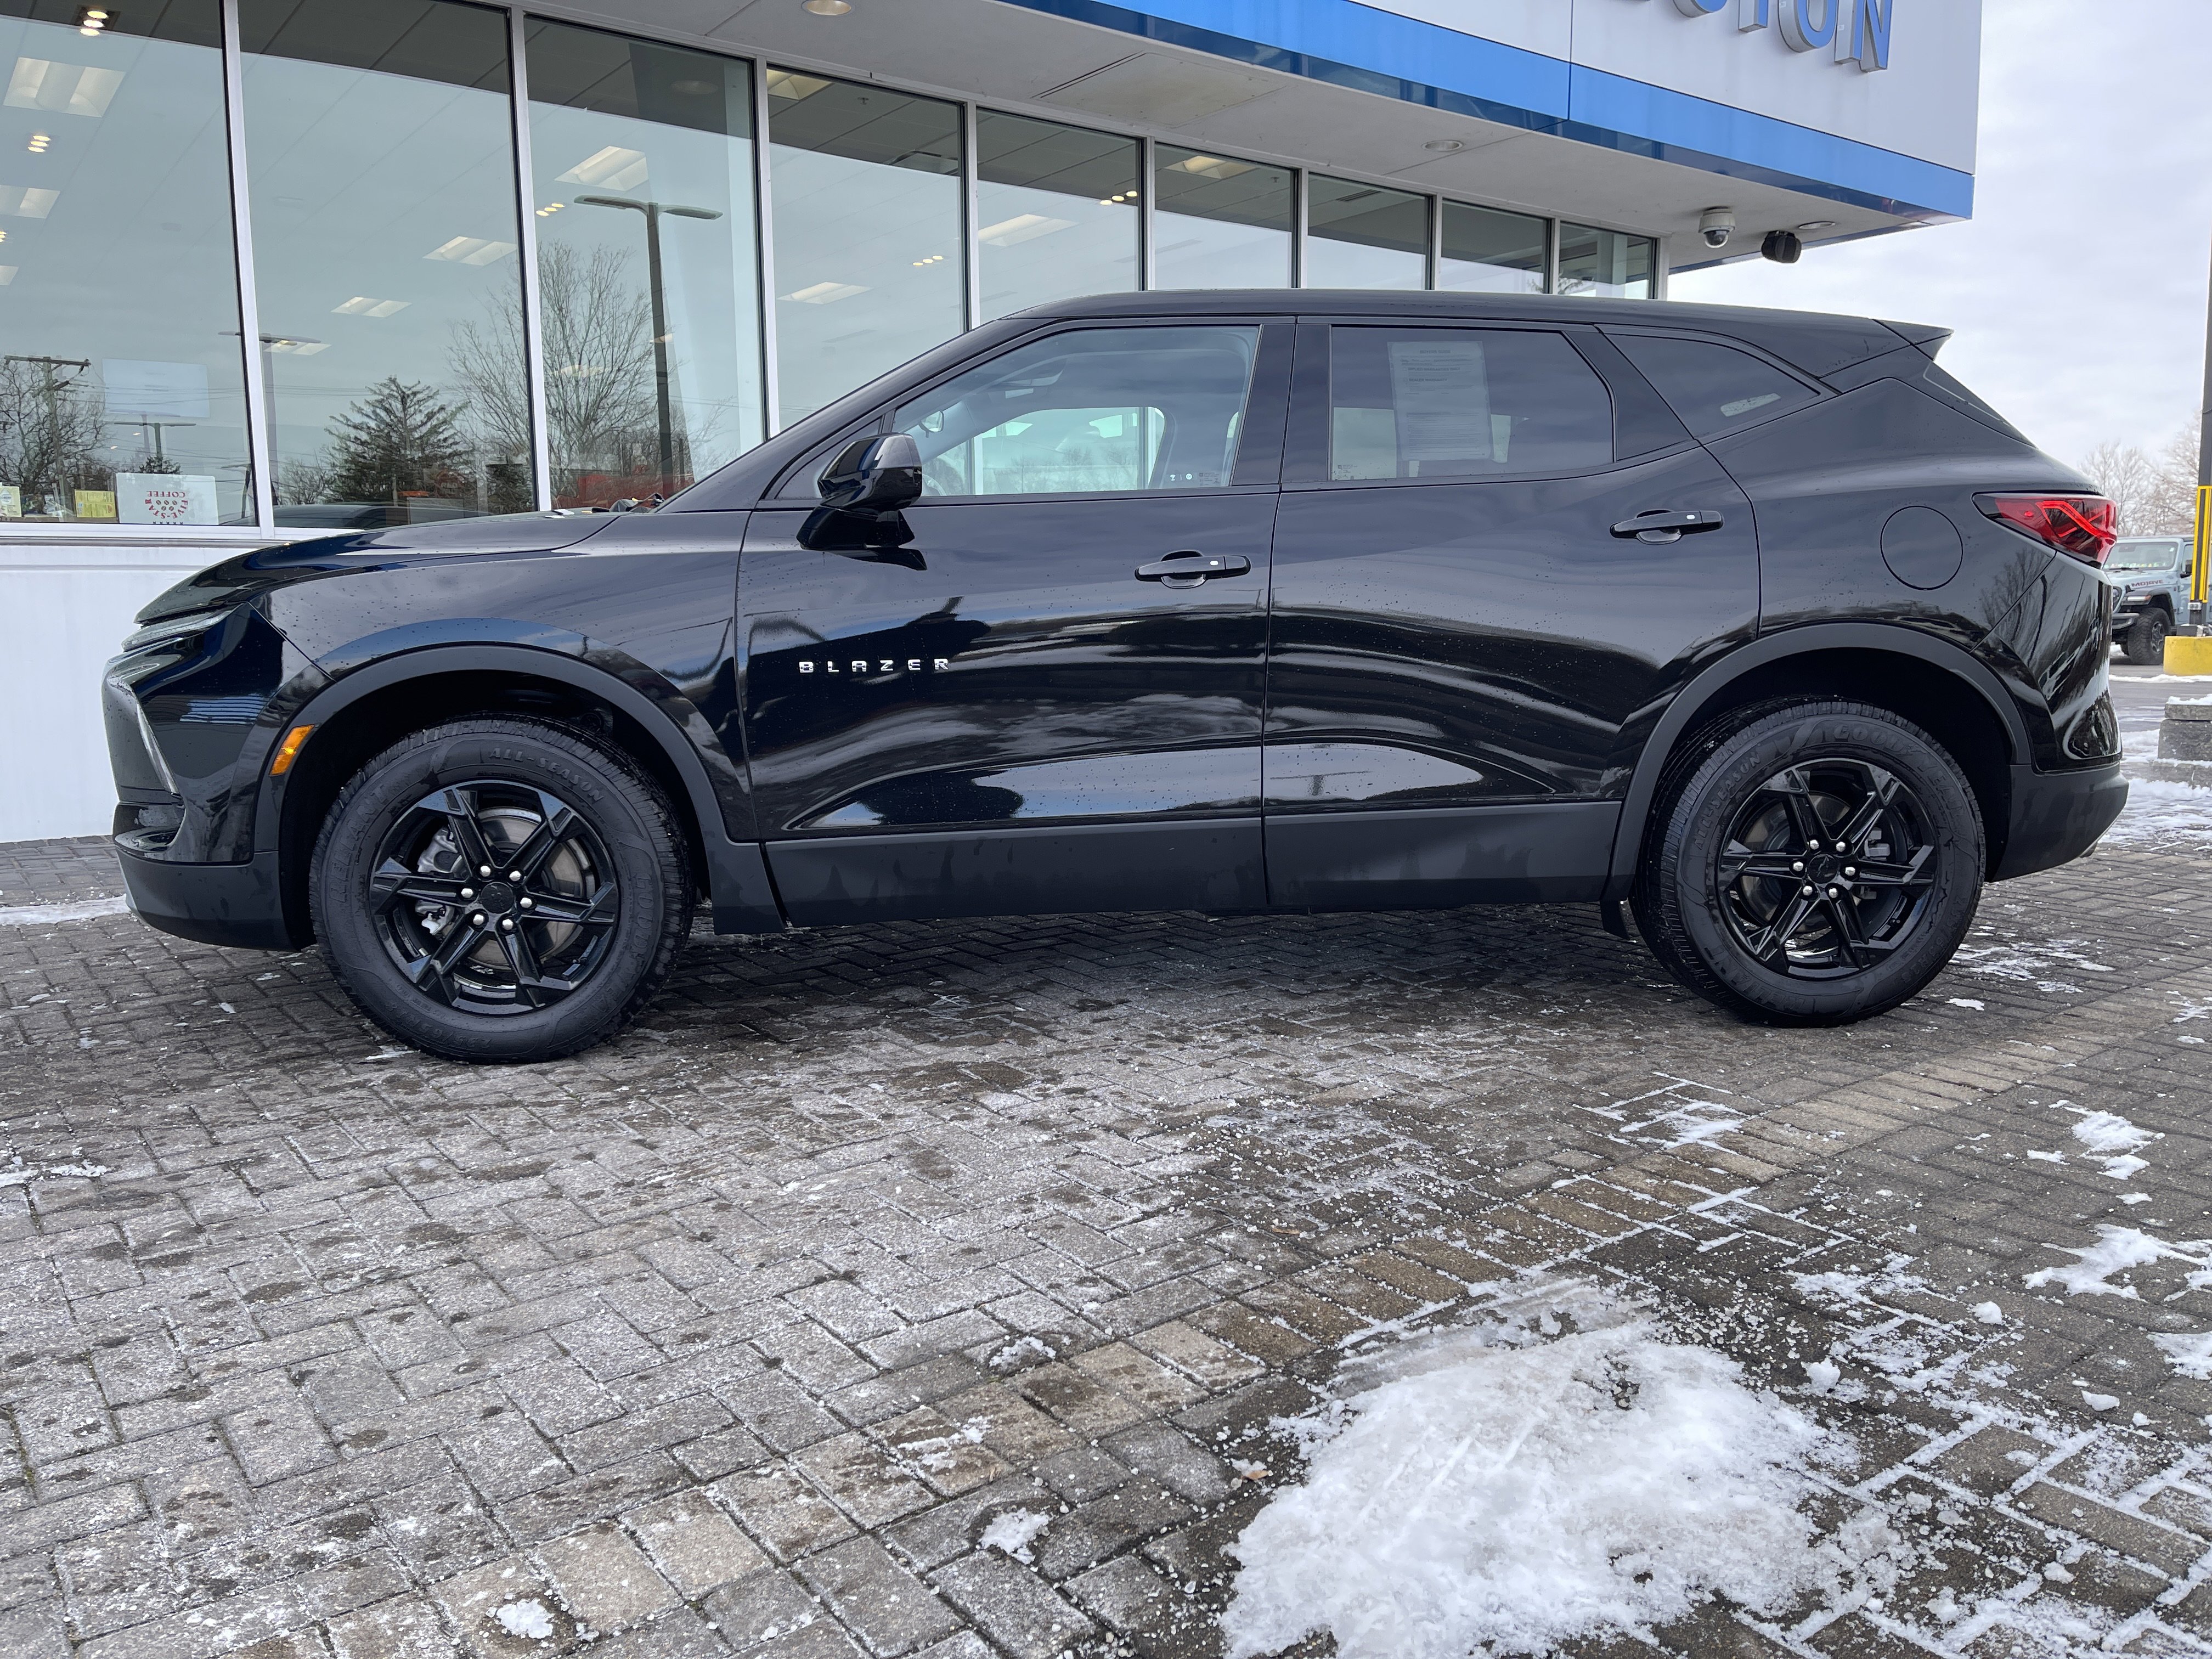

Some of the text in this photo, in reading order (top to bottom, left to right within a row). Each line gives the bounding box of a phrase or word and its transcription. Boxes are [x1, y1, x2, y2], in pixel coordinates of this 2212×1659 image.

[145, 499, 188, 519] FIVE-STAR
[799, 658, 949, 673] BLAZER
[489, 748, 604, 802] ALL-SEASON
[1694, 752, 1760, 850] ALL-SEASON
